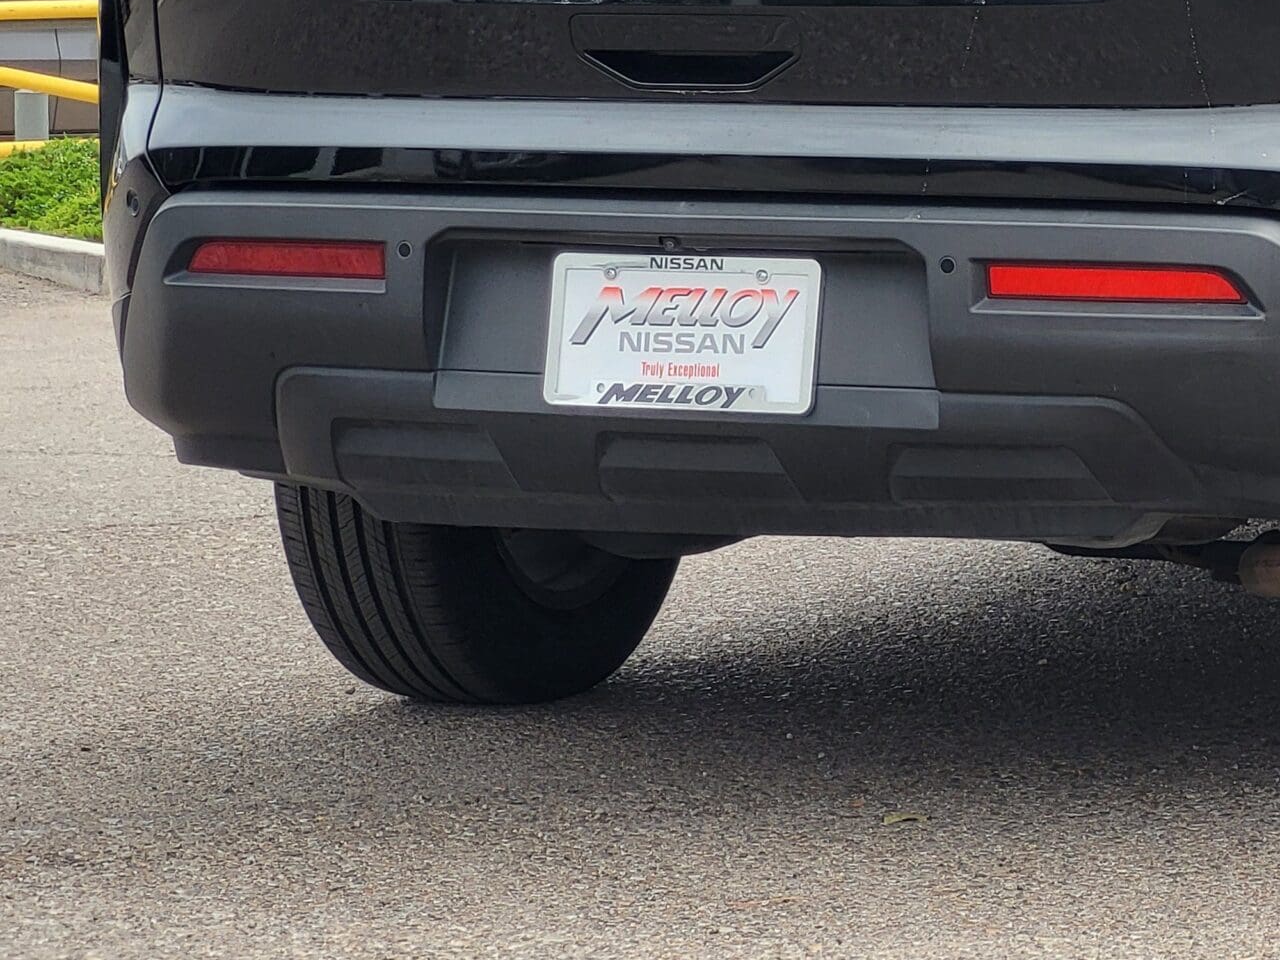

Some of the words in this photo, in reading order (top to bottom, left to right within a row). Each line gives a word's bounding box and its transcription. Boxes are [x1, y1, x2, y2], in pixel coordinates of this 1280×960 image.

[649, 257, 725, 271] NISSAN
[569, 286, 800, 349] MELLOY
[619, 331, 745, 355] NISSAN
[641, 361, 664, 378] Truly
[668, 362, 720, 378] Exceptional
[598, 382, 745, 409] MELLOY
